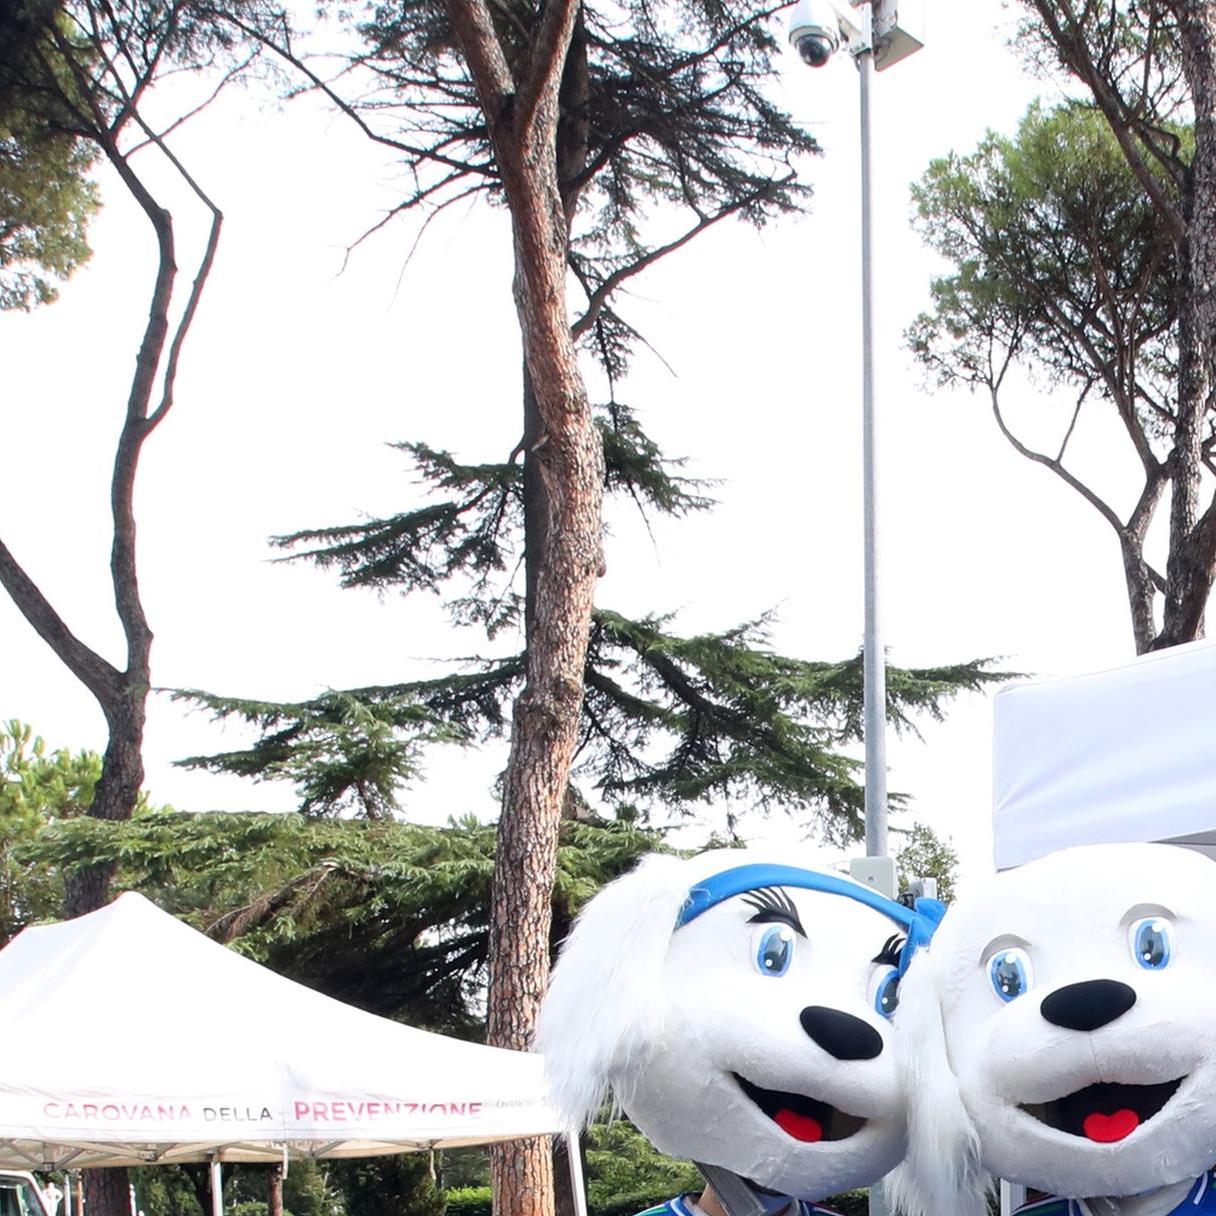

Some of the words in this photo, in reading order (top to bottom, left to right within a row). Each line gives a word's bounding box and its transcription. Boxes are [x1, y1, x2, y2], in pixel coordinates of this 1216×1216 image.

[43, 1102, 193, 1122] CAROVANA
[203, 1106, 274, 1122] DELLA
[295, 1101, 482, 1122] PREVENZIONE
